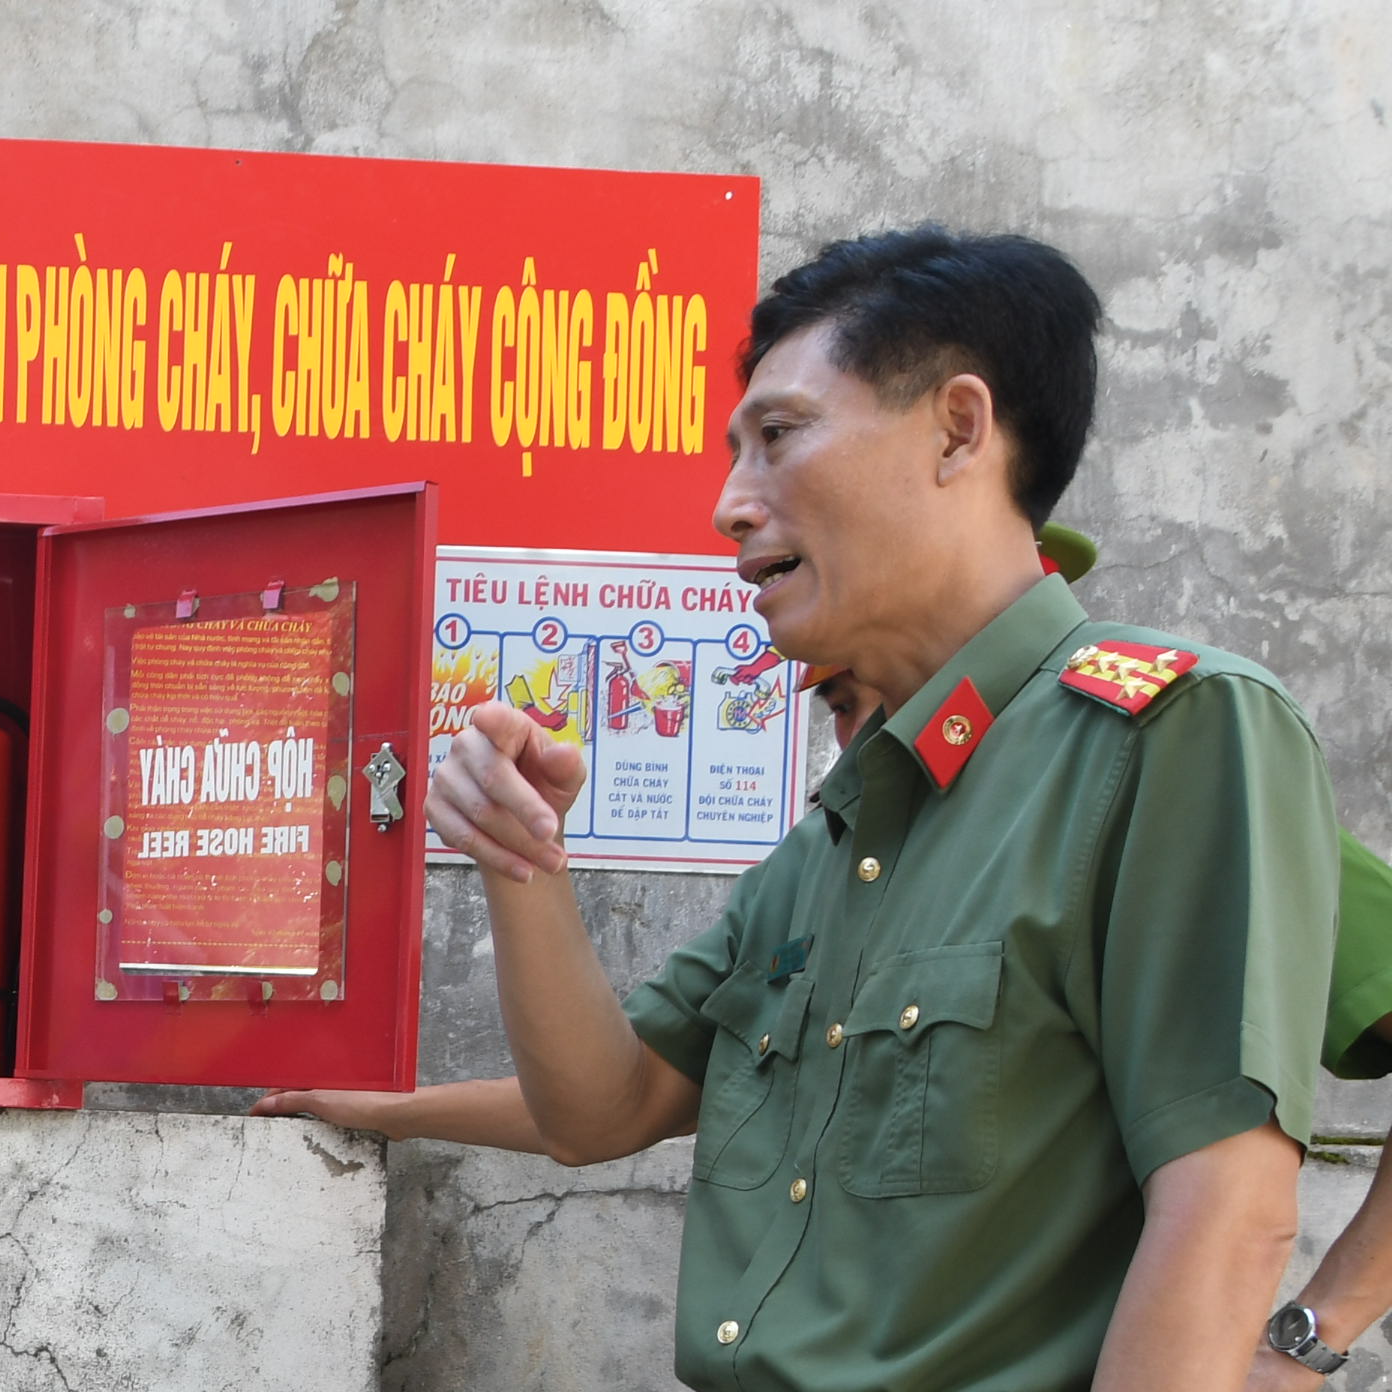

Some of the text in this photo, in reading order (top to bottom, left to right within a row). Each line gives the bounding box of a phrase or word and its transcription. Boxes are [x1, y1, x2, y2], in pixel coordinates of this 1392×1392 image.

[16, 232, 147, 430] PHÒNG
[157, 241, 261, 455] CHÁY,
[271, 253, 370, 440] CHỮA
[382, 253, 482, 443] CHÁY
[490, 256, 594, 477] CỘNG
[602, 248, 707, 456] ĐỒNG
[446, 572, 753, 613] TIÊU LỆNH CHỮA CHÁY
[445, 619, 457, 642] 1
[541, 623, 558, 646] 2
[639, 627, 654, 649] 3
[732, 631, 750, 653] 4
[736, 780, 757, 791] 114
[697, 810, 774, 824] CHUYÊN NGHIỆP
